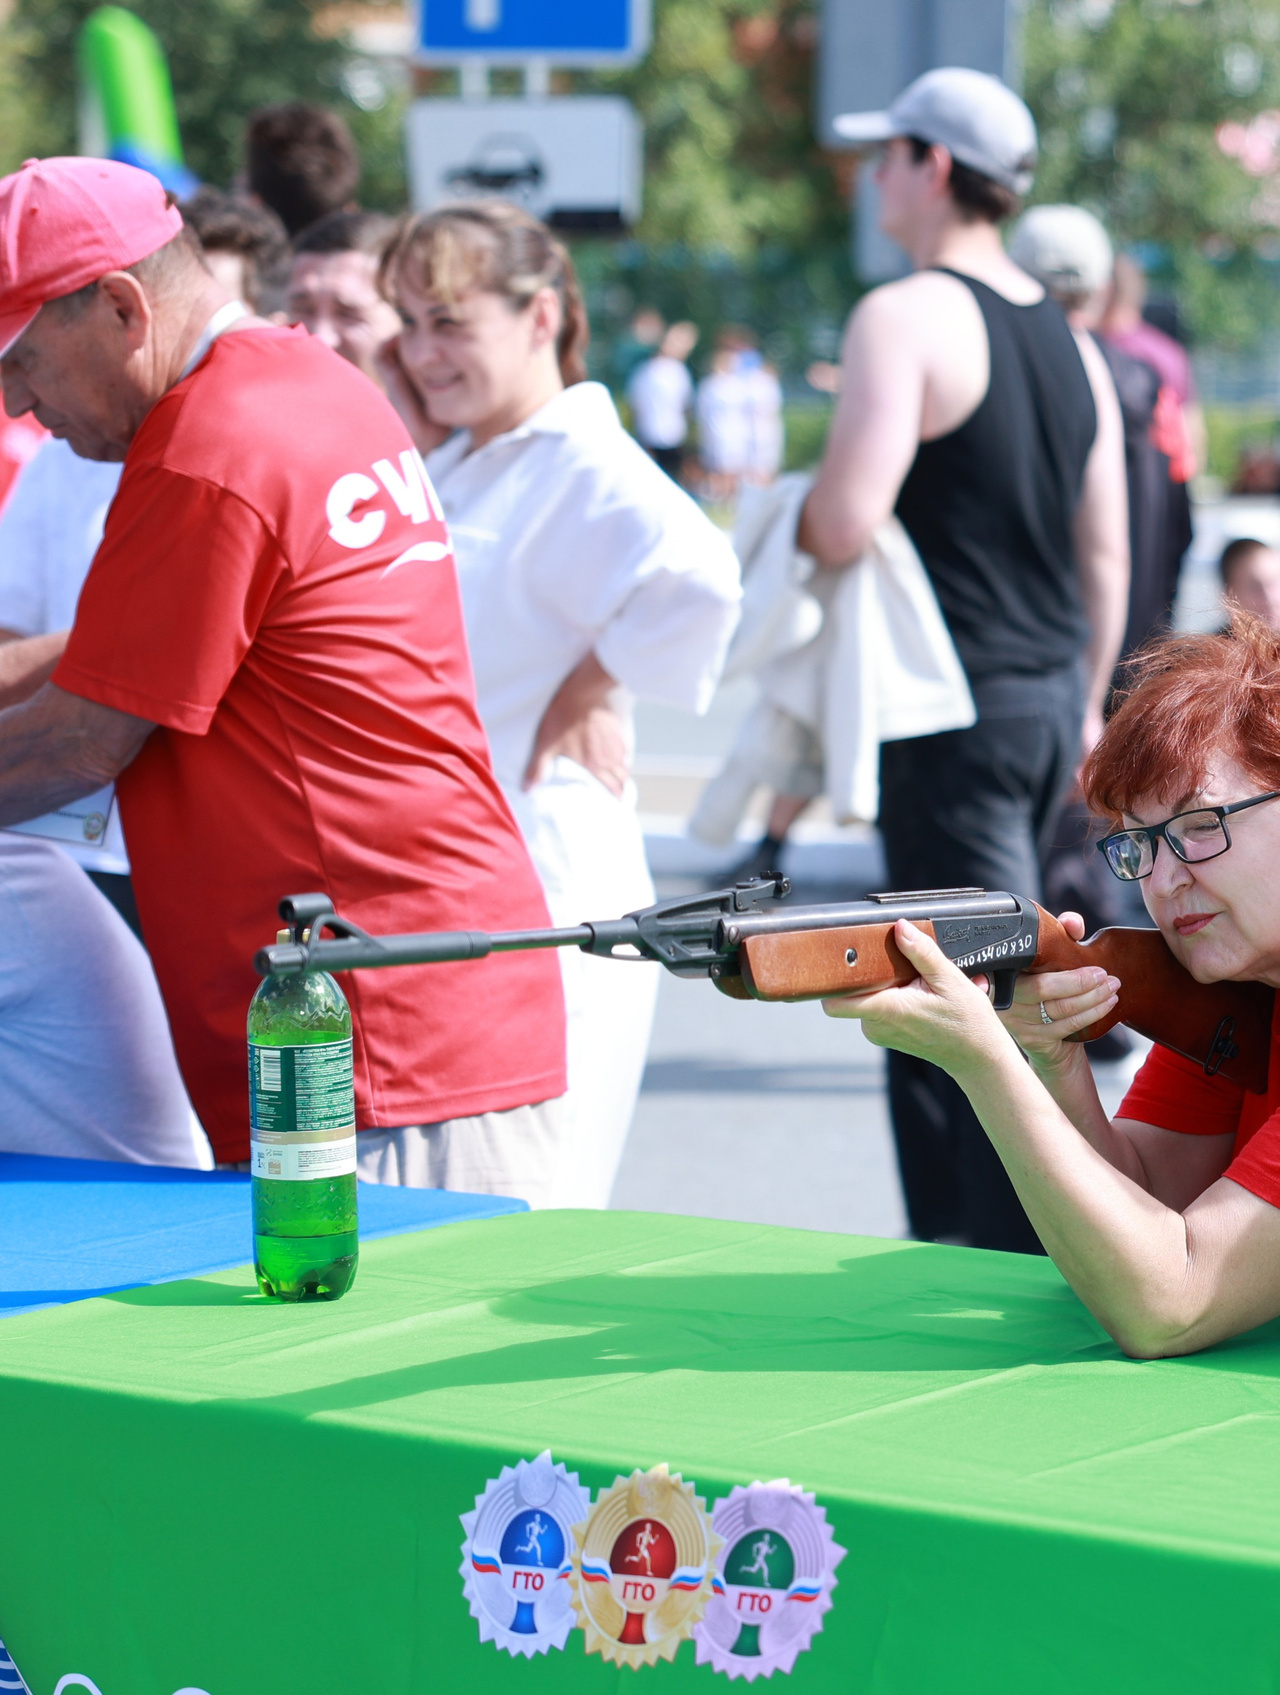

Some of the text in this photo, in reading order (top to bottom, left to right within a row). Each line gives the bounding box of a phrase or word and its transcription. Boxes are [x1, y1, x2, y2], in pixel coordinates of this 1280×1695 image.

[512, 1571, 544, 1591] ГТО
[622, 1580, 656, 1602] ГТО
[737, 1592, 772, 1614] ГТО
